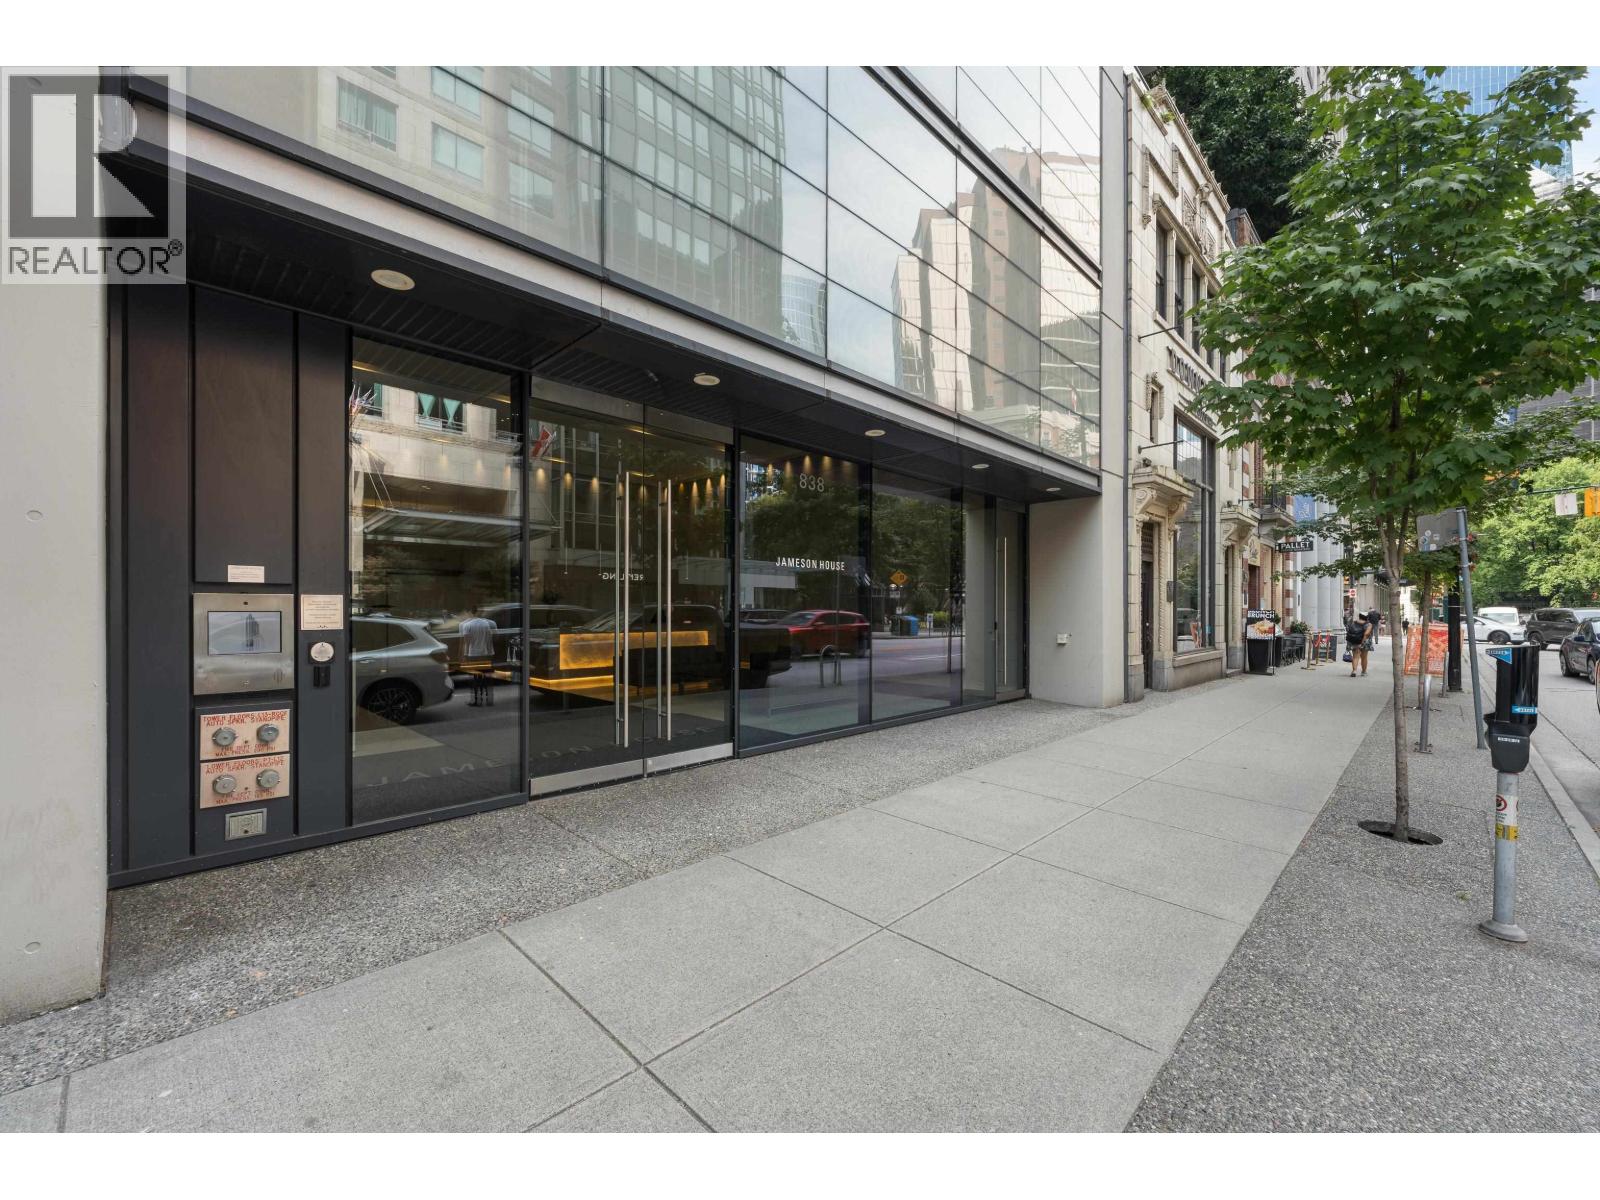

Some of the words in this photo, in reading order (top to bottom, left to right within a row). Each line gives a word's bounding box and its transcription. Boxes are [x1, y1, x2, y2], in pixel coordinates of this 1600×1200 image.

[800, 473, 824, 492] 838
[1280, 541, 1311, 549] PALLET
[775, 557, 817, 569] JAMESON
[819, 560, 845, 571] HOUSE
[206, 719, 224, 727] AUTO
